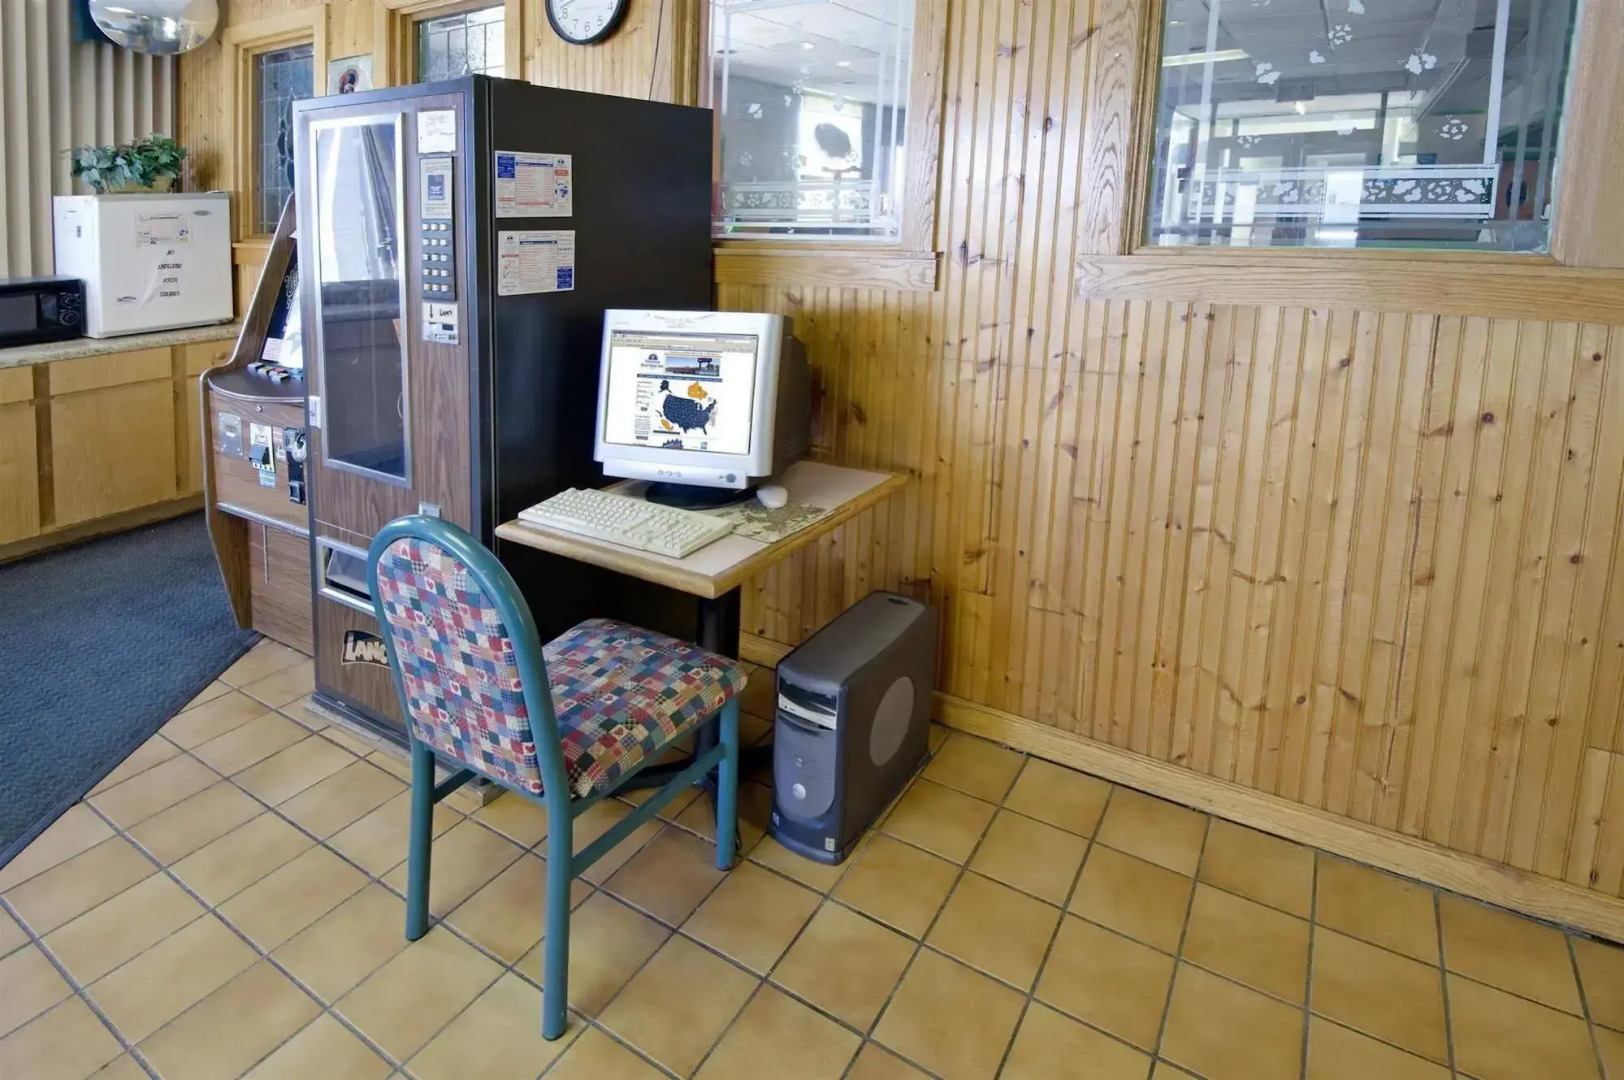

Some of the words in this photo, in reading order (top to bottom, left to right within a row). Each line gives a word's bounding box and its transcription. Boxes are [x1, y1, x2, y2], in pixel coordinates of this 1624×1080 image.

[562, 8, 568, 19] 8
[572, 19, 578, 30] 7
[584, 21, 591, 33] 6
[597, 15, 603, 27] 5
[345, 632, 388, 664] LANC
